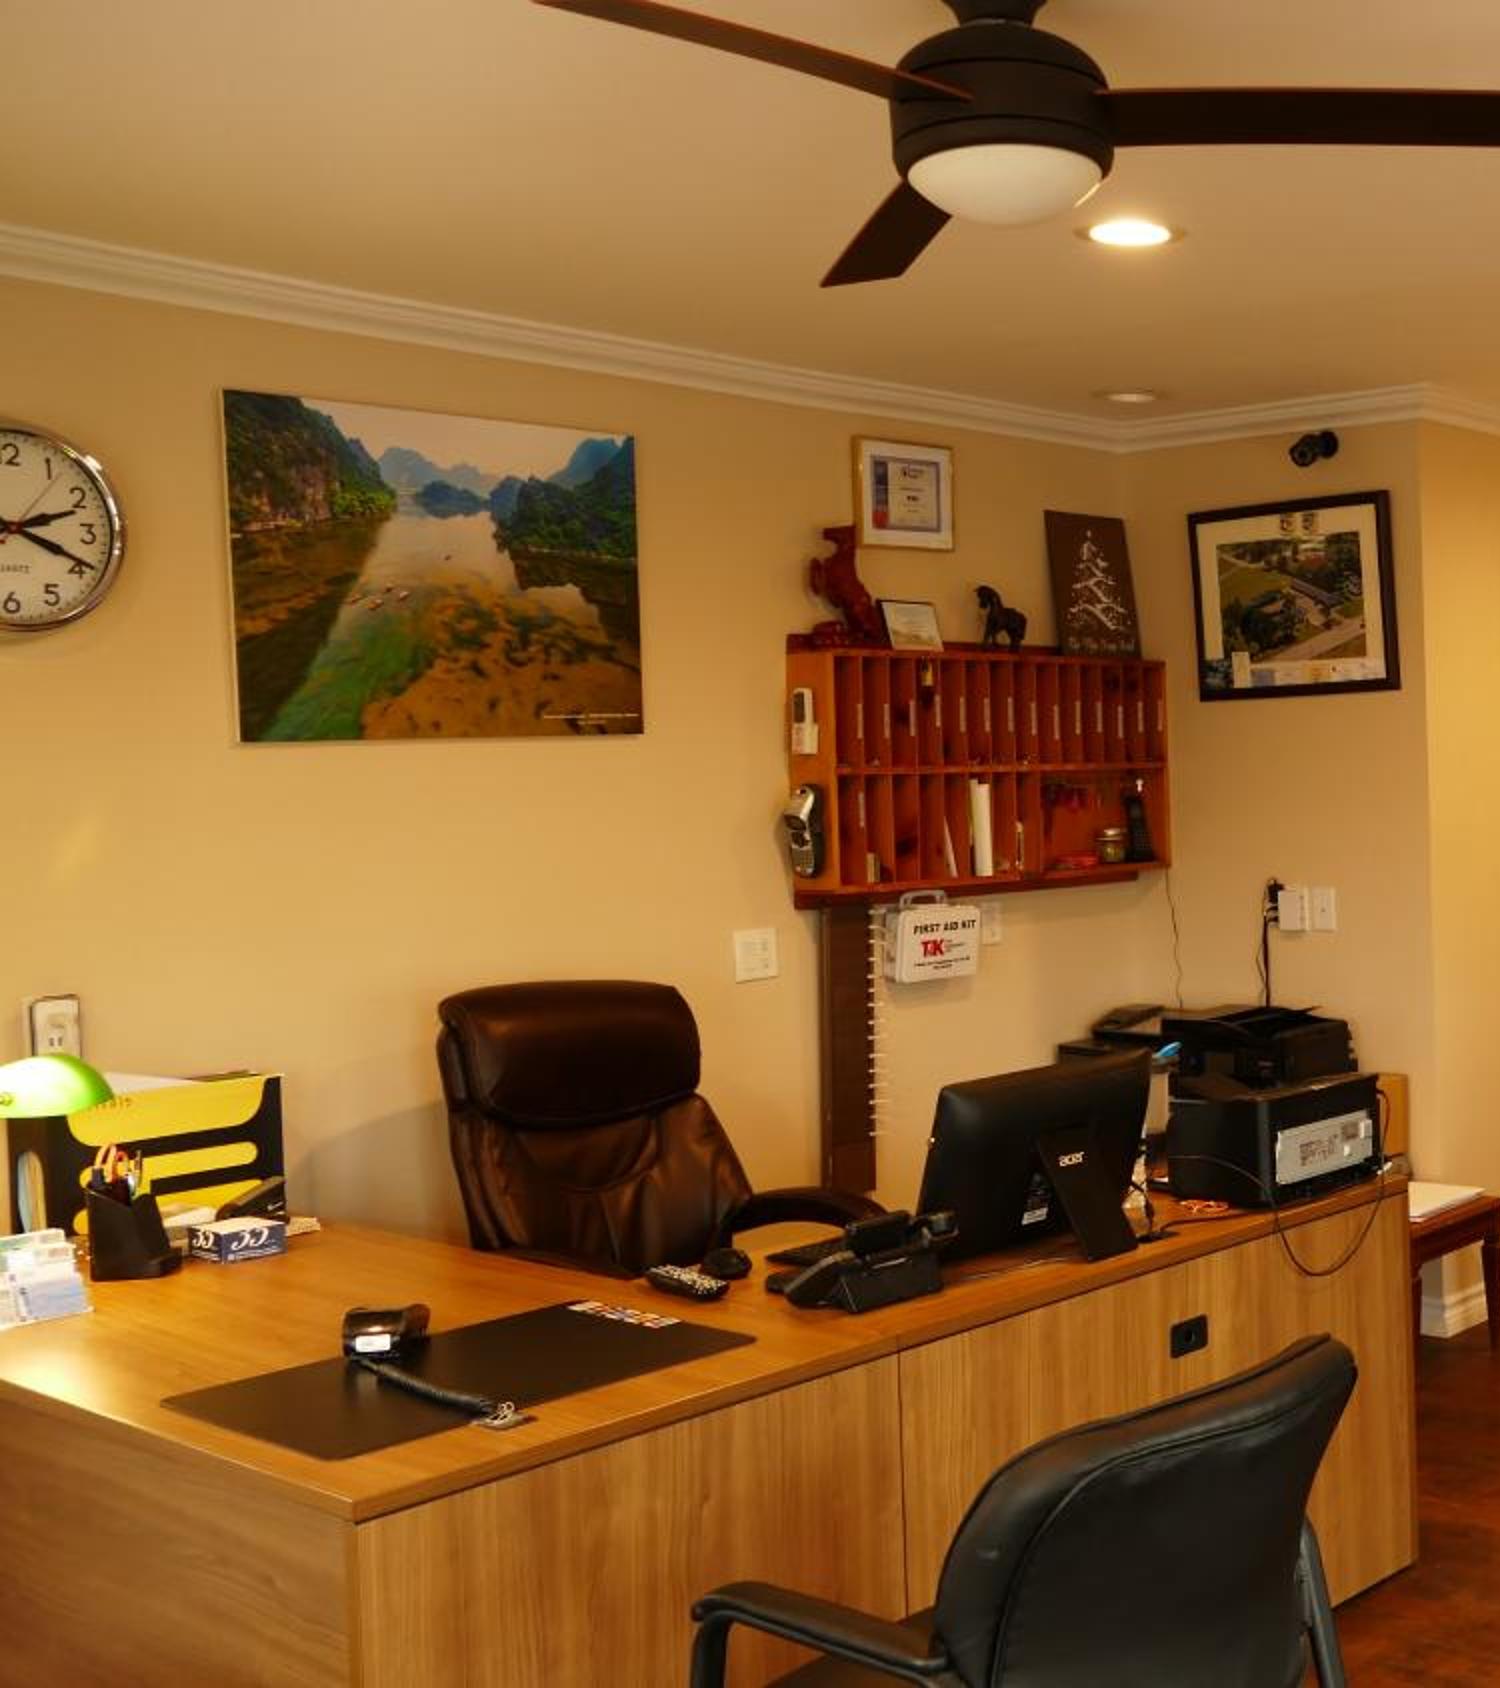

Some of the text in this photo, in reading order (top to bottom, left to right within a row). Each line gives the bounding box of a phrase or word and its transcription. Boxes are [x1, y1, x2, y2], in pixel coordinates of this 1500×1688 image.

[0, 443, 20, 466] 2
[45, 457, 52, 480] 1
[69, 487, 87, 509] 2
[79, 523, 97, 545] 3
[67, 558, 87, 579] 4
[3, 591, 21, 614] 6
[43, 583, 61, 606] 5
[913, 919, 977, 935] FIRST AID KIT
[1059, 1151, 1085, 1167] acer
